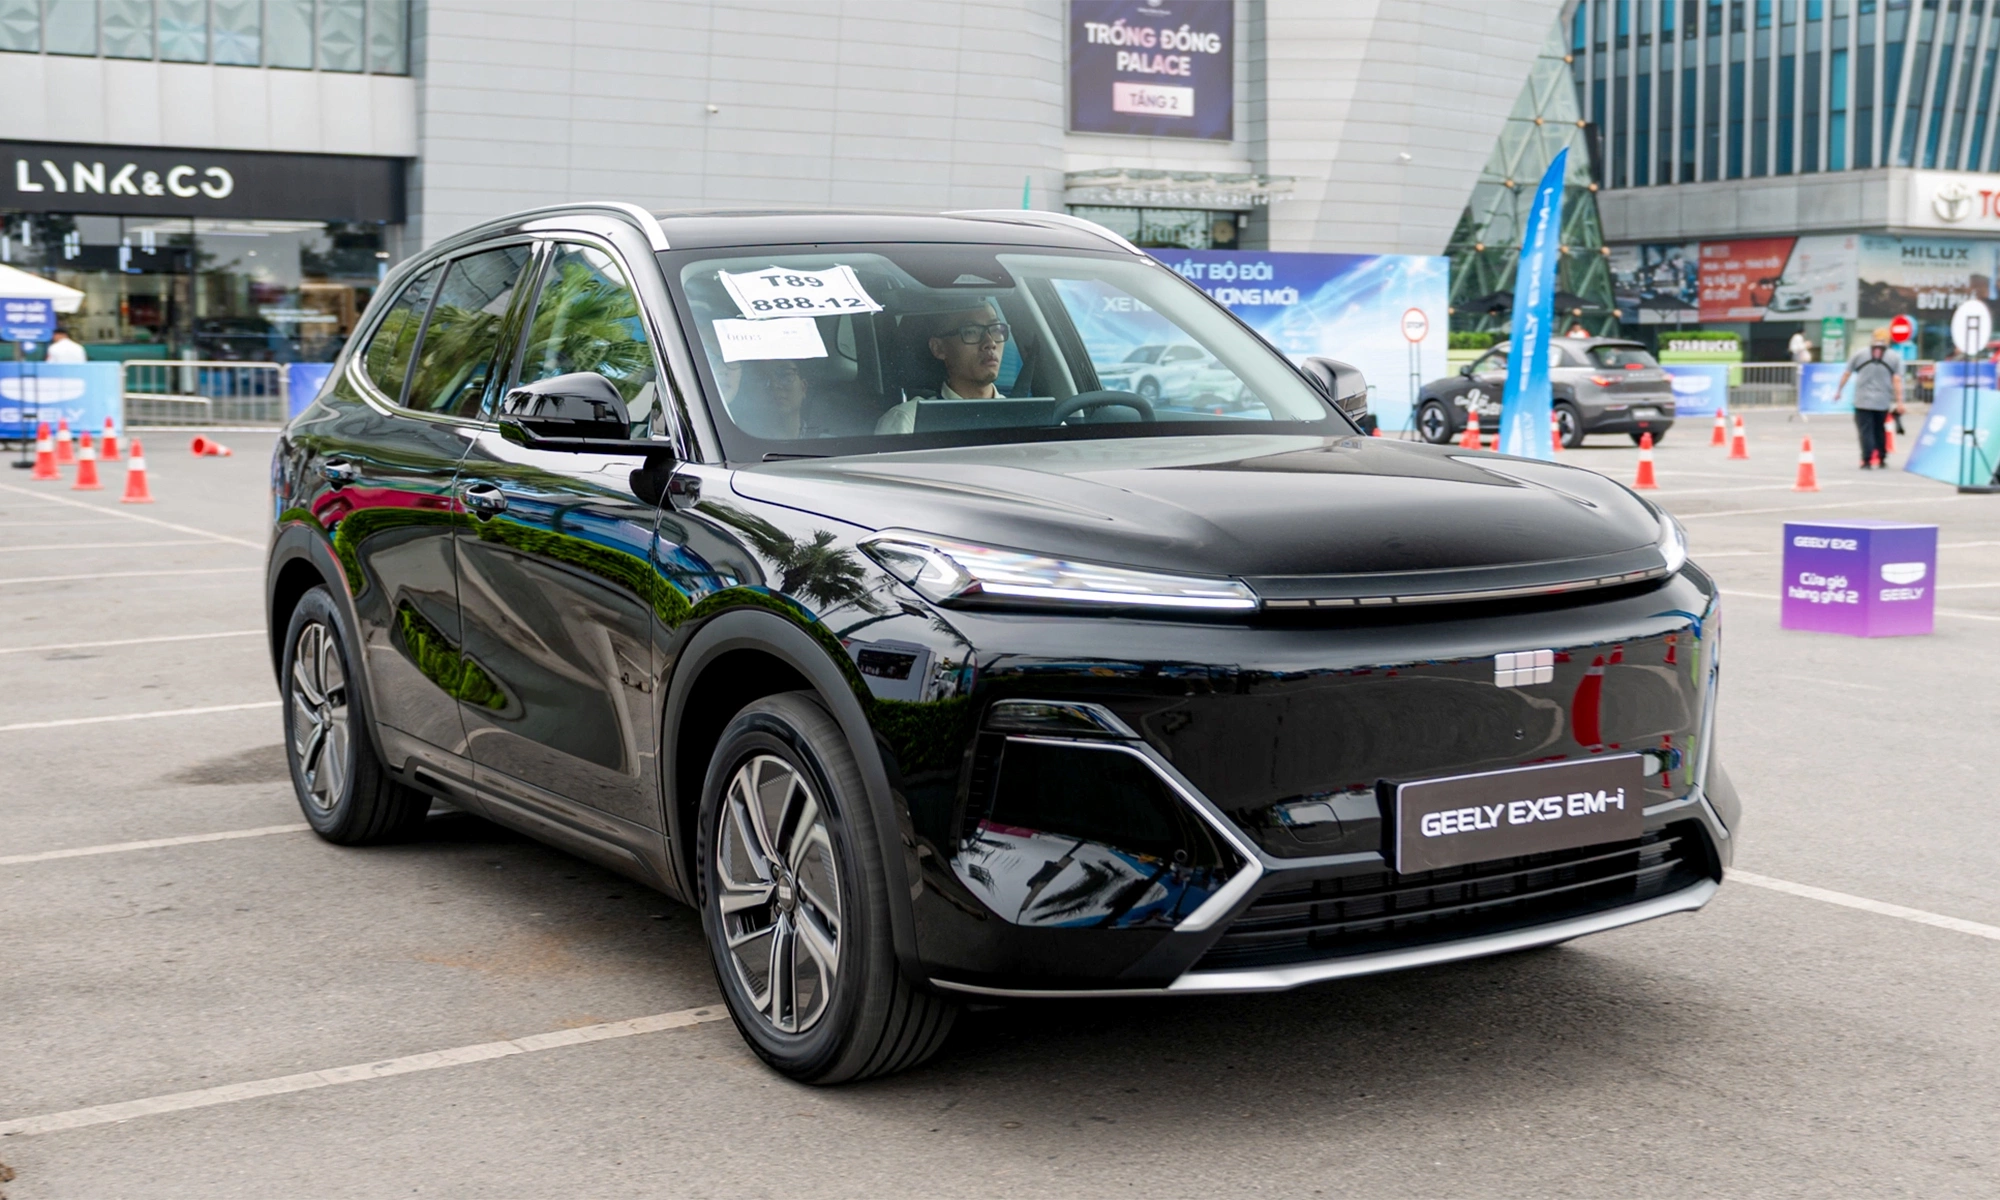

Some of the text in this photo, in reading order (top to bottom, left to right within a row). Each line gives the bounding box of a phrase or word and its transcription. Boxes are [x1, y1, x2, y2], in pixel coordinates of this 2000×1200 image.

[1084, 18, 1157, 48] TRỐNG
[1116, 51, 1191, 76] PALACE
[1169, 96, 1179, 110] 2
[1901, 246, 1969, 260] HILUX
[1208, 260, 1238, 282] BỘ
[1239, 261, 1273, 281] ĐÔI
[760, 275, 824, 288] T89
[1262, 285, 1299, 306] MỚI
[751, 297, 866, 312] 888.12
[1102, 297, 1131, 312] XE
[1669, 340, 1737, 351] STARBUCKS
[1793, 536, 1829, 549] GEELY
[1845, 591, 1859, 604] 2
[1879, 588, 1925, 602] GEELY
[1421, 787, 1625, 837] GEELY EX5 EM-i
